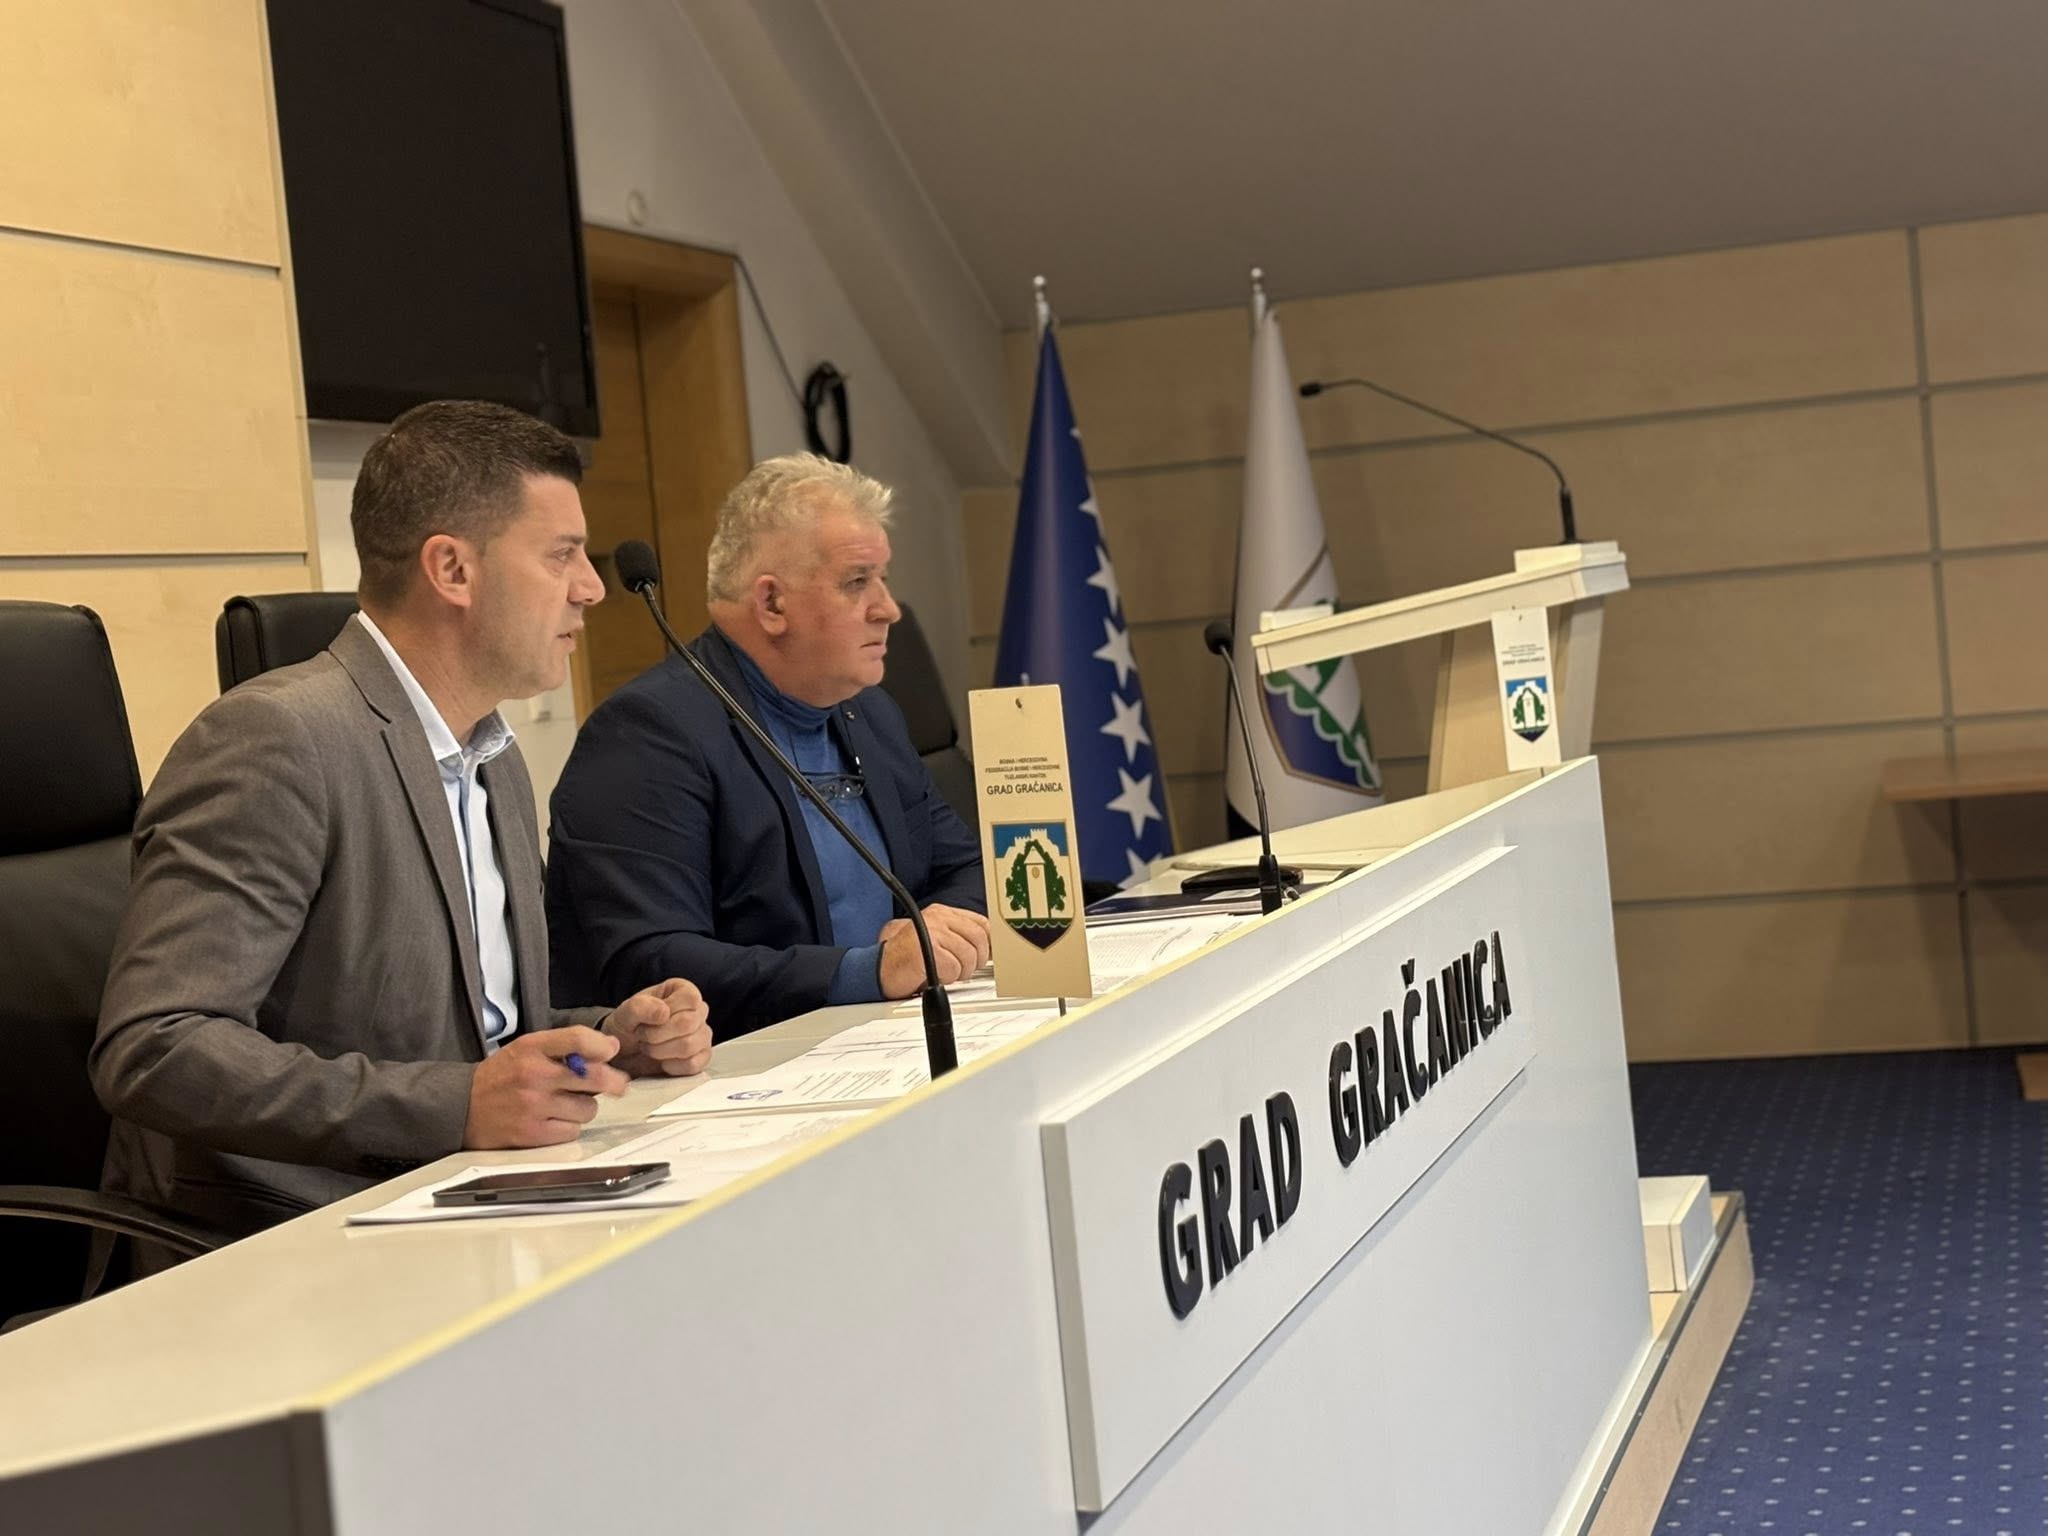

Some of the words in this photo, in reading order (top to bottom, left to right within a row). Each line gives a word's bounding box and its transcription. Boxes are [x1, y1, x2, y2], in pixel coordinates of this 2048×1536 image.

[987, 784, 1013, 795] GRAD
[1015, 781, 1063, 794] GRAČANICA
[1158, 1091, 1302, 1320] GRAD
[1329, 930, 1512, 1168] GRAČANICA
